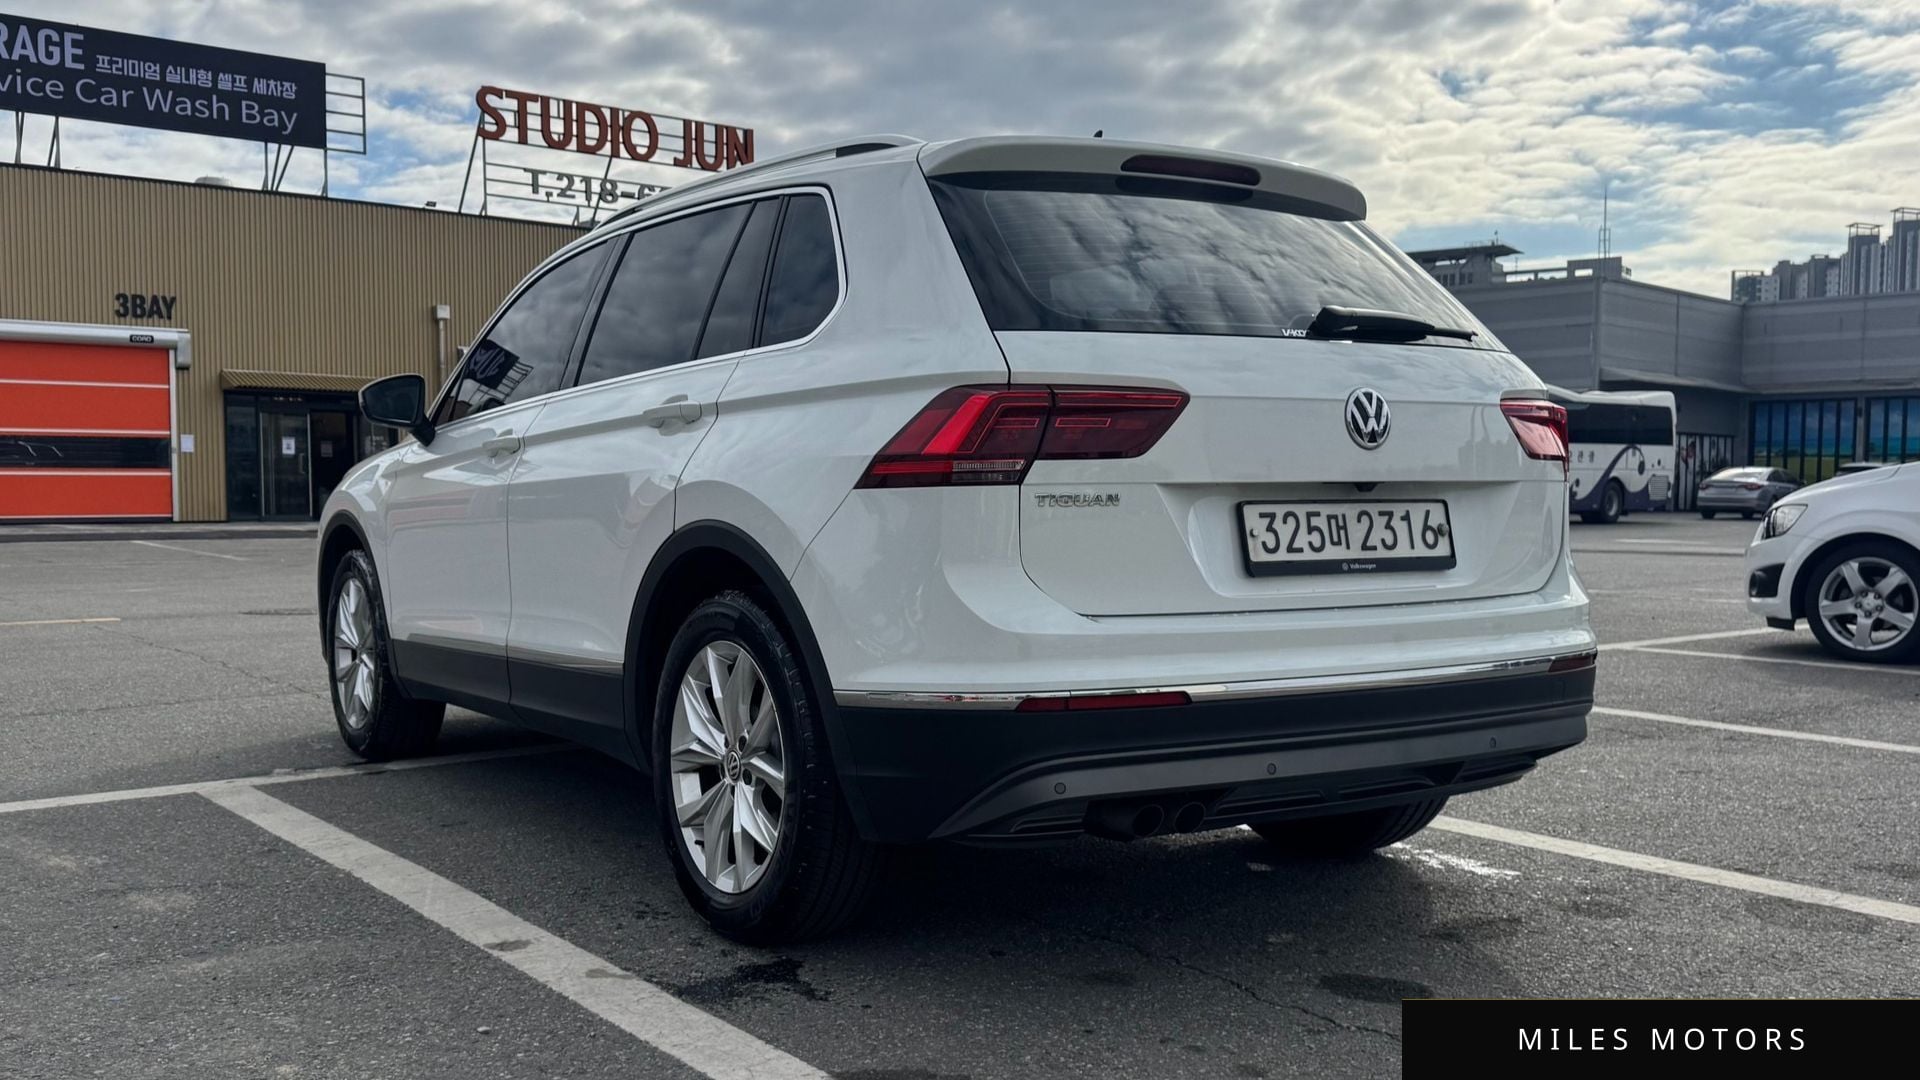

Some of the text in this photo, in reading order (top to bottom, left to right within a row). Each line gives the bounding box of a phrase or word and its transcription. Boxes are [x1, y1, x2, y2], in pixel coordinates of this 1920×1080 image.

[95, 54, 297, 100] 프리미엄 실내형 셀프 세차장
[75, 77, 134, 108] Car
[142, 86, 230, 121] Wash
[241, 99, 298, 135] Bay
[476, 86, 754, 171] STUDIO JUN
[114, 292, 177, 321] 3BAY
[1035, 492, 1120, 508] TIGUAN
[1258, 509, 1439, 554] 325머 2316
